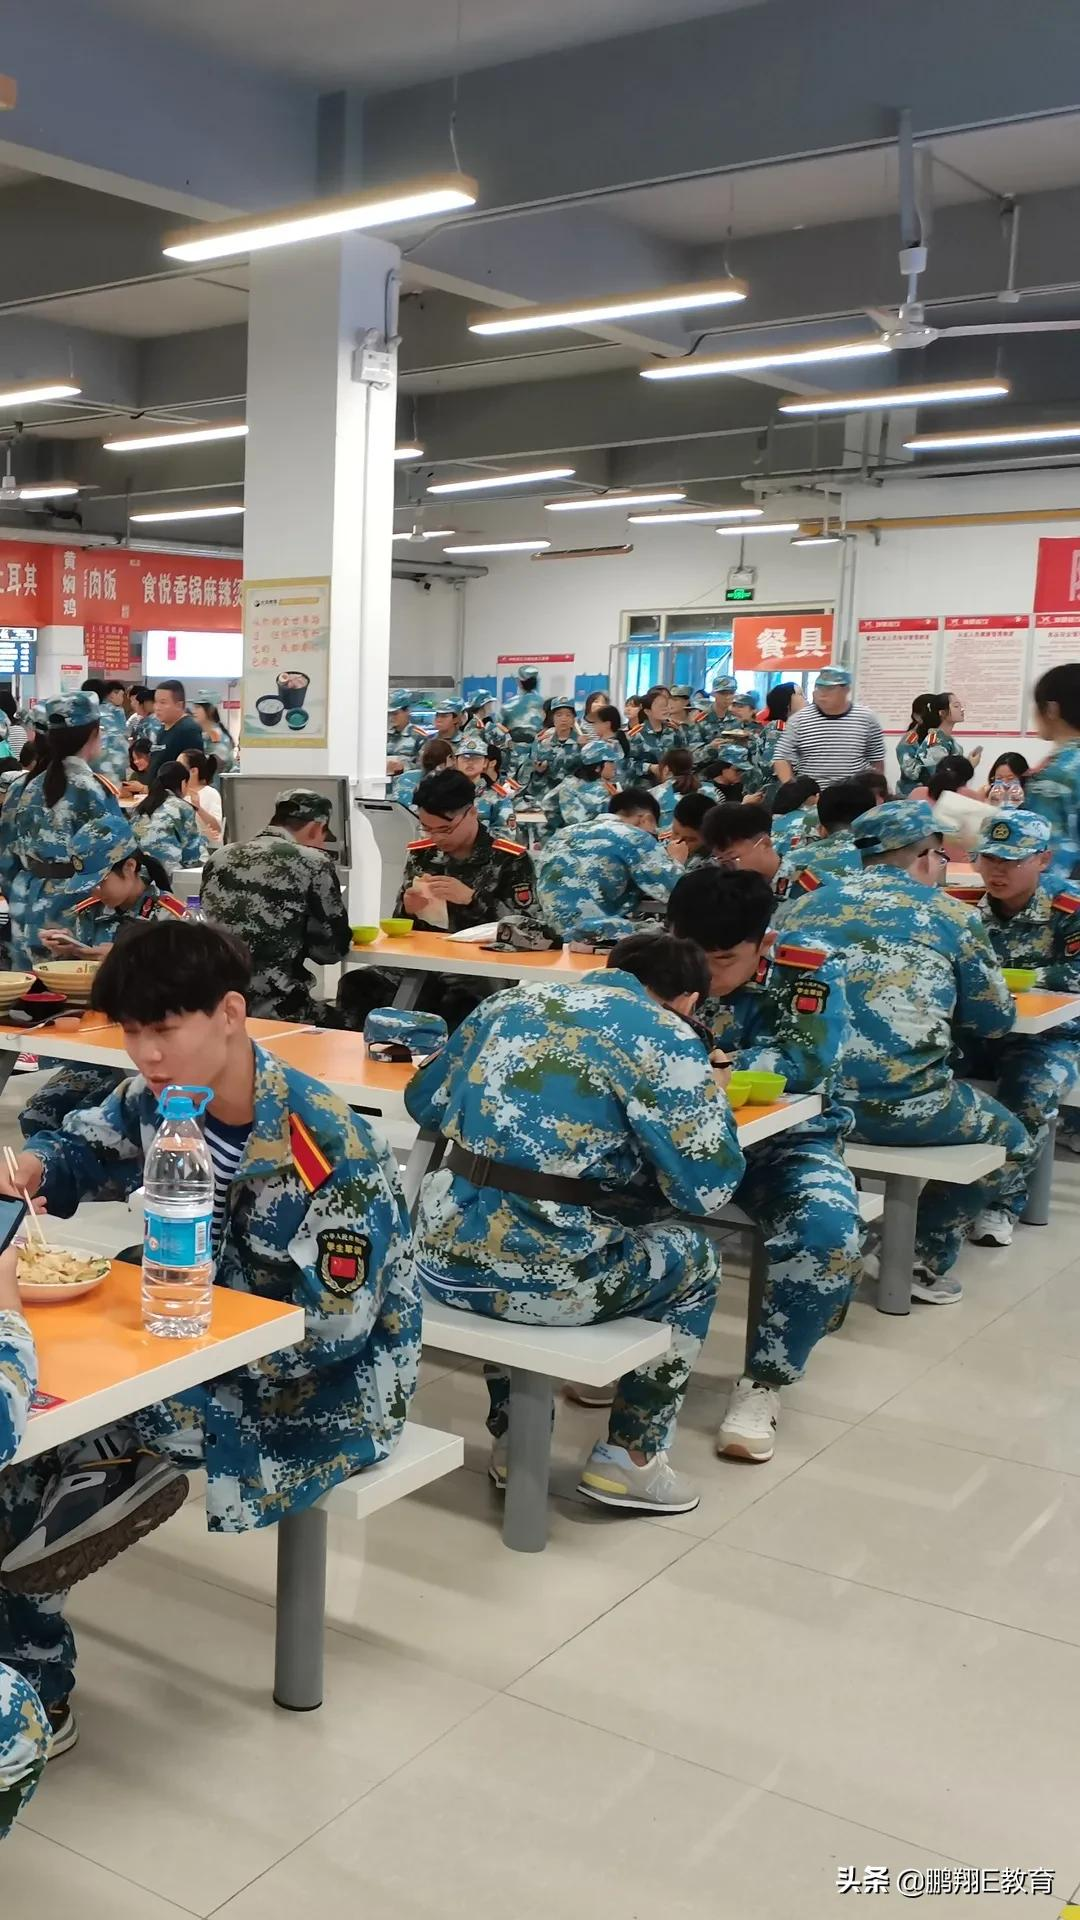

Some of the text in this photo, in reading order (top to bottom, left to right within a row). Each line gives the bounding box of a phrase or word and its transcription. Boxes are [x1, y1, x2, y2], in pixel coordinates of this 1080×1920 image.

[62, 551, 77, 617] 黄焖鸡
[756, 627, 827, 659] 餐具
